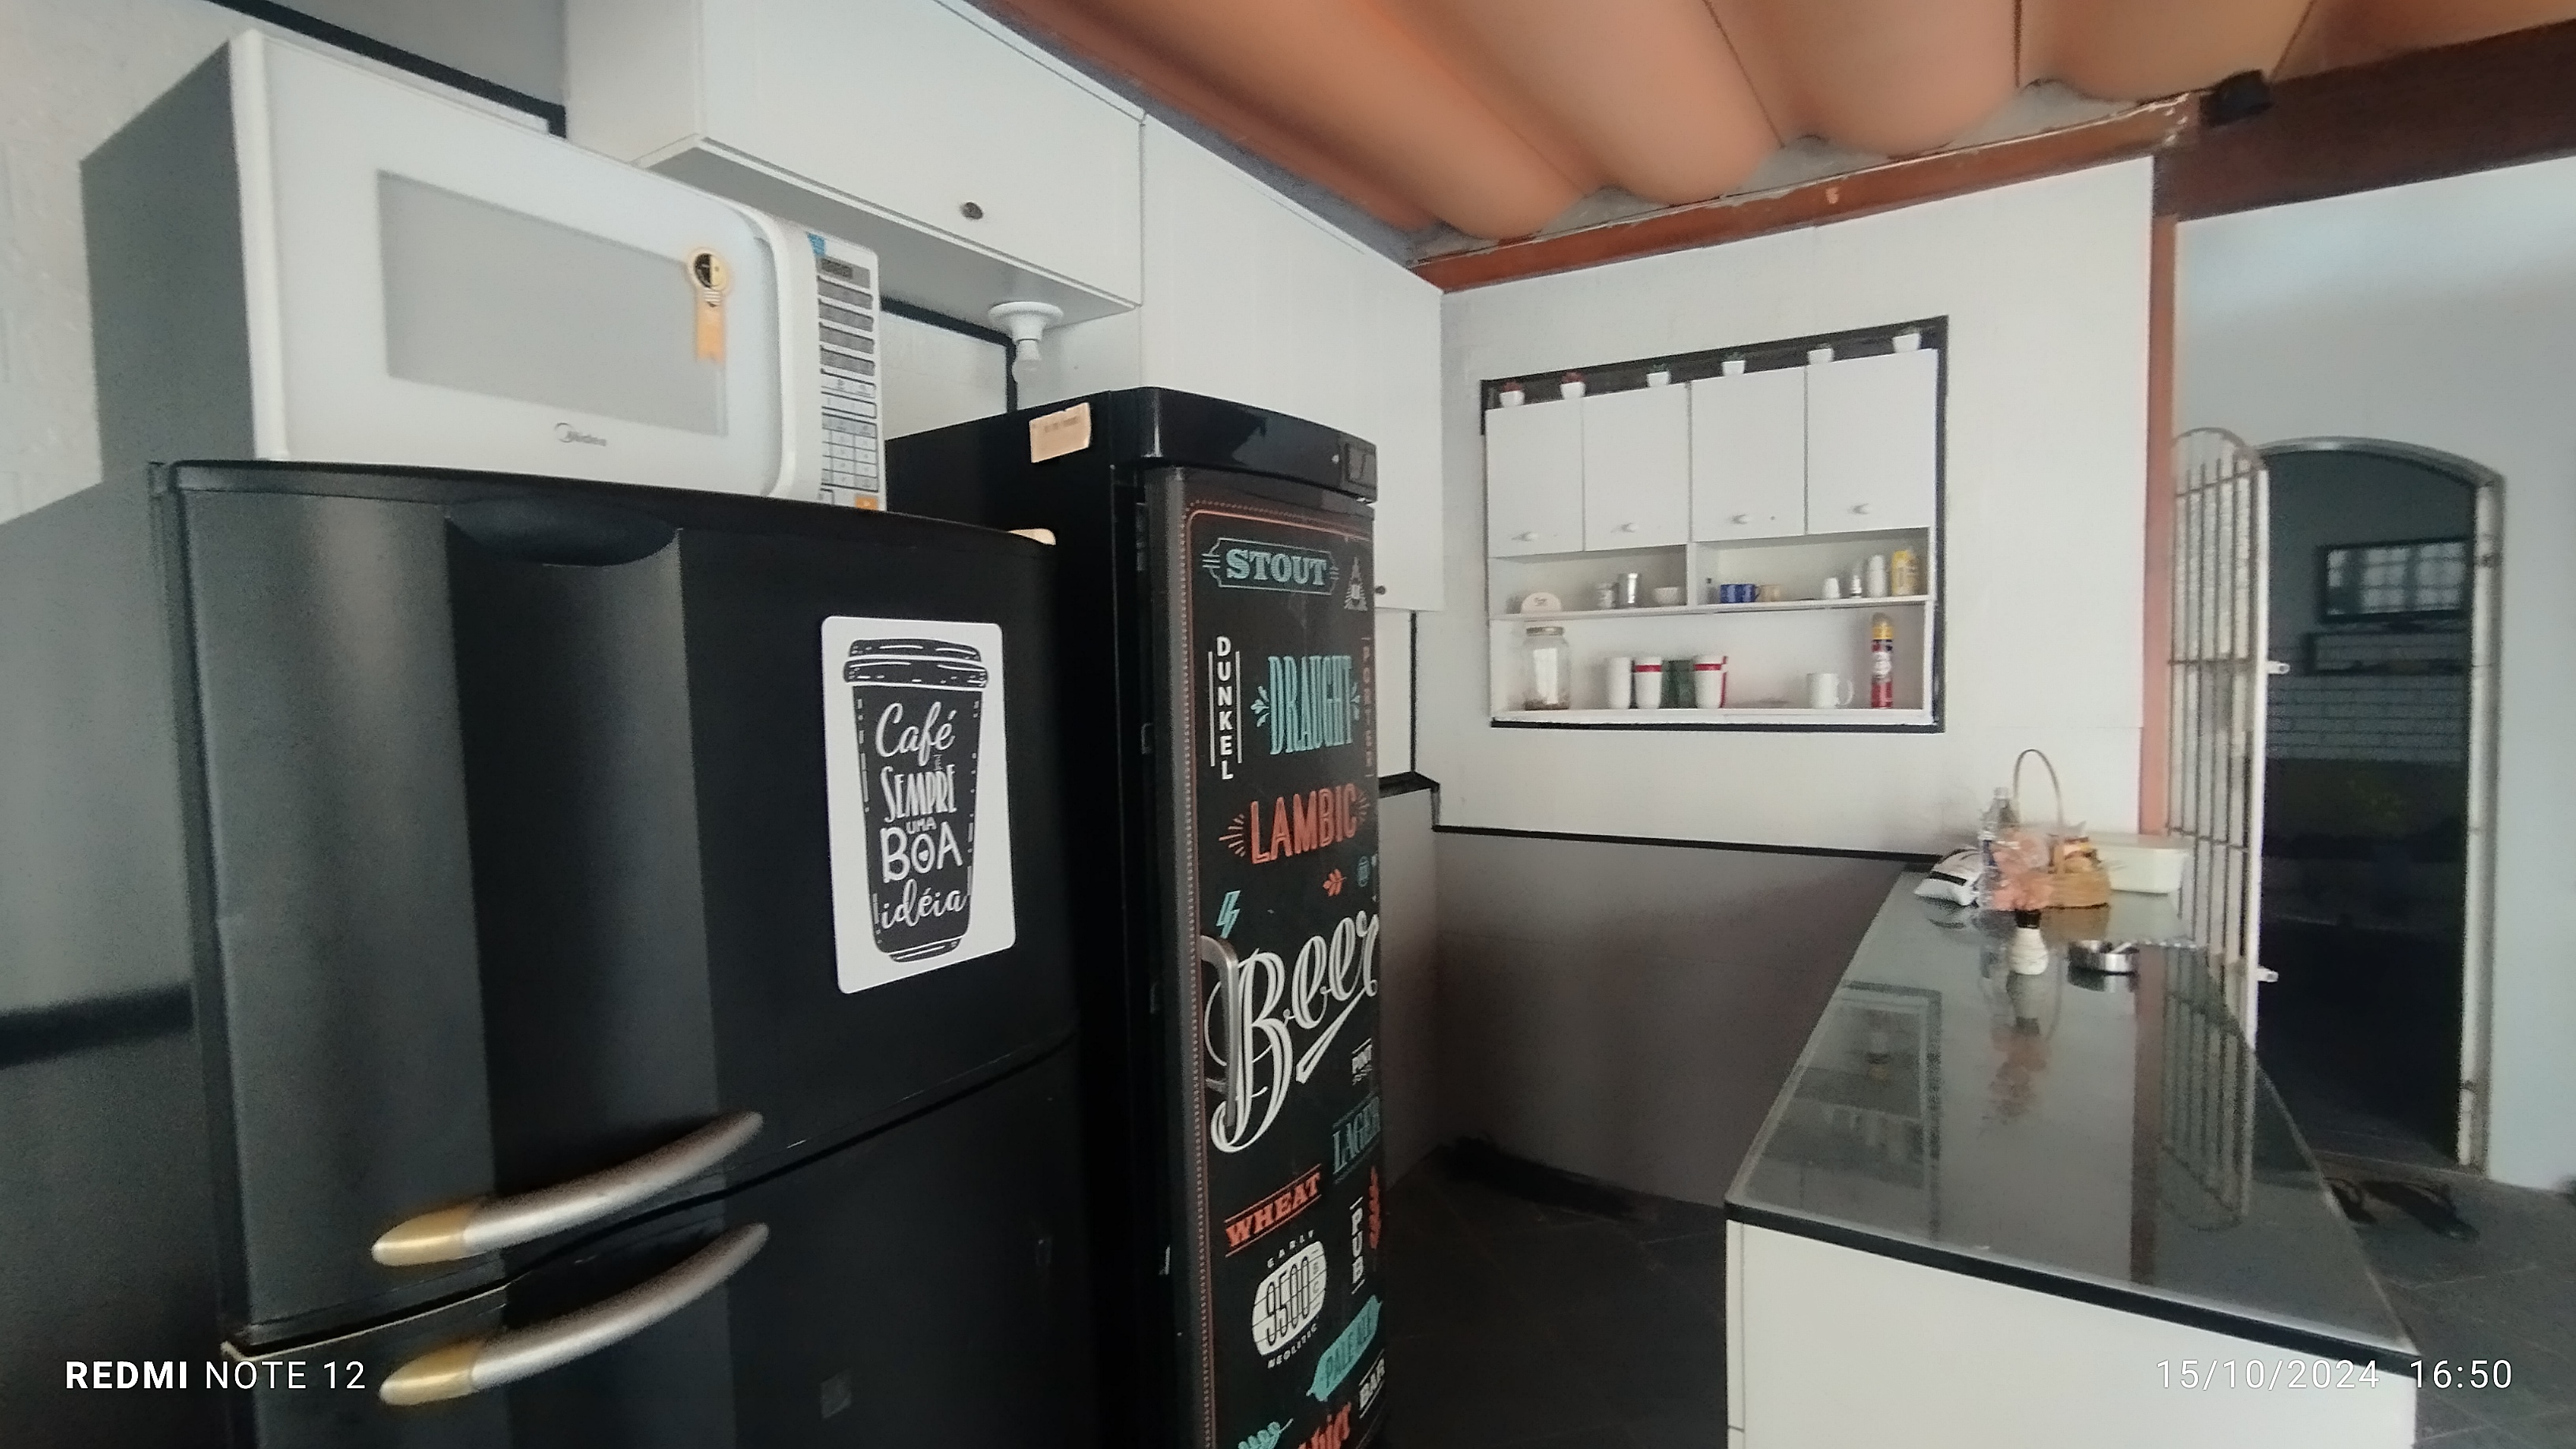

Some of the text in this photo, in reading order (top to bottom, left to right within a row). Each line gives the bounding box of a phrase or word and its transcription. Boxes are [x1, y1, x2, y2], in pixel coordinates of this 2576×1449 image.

[1226, 548, 1327, 587] STOUT
[874, 700, 957, 767] Café
[1216, 635, 1234, 781] DUNKEL
[1267, 654, 1354, 755] DRAUGHT
[879, 763, 957, 823] SEMPRE
[905, 815, 938, 835] UMA
[1250, 783, 1359, 865] LAMBIC
[879, 821, 964, 884] BOA
[881, 878, 969, 930] idéia
[1205, 910, 1380, 1153] Beer
[1225, 1171, 1322, 1249] WHEAT
[1266, 1229, 1315, 1269] EARLY
[1351, 1207, 1364, 1285] PUB
[1266, 1255, 1311, 1347] 9500
[1267, 1322, 1319, 1370] NEOLITIC
[1358, 1357, 1386, 1411] BAR
